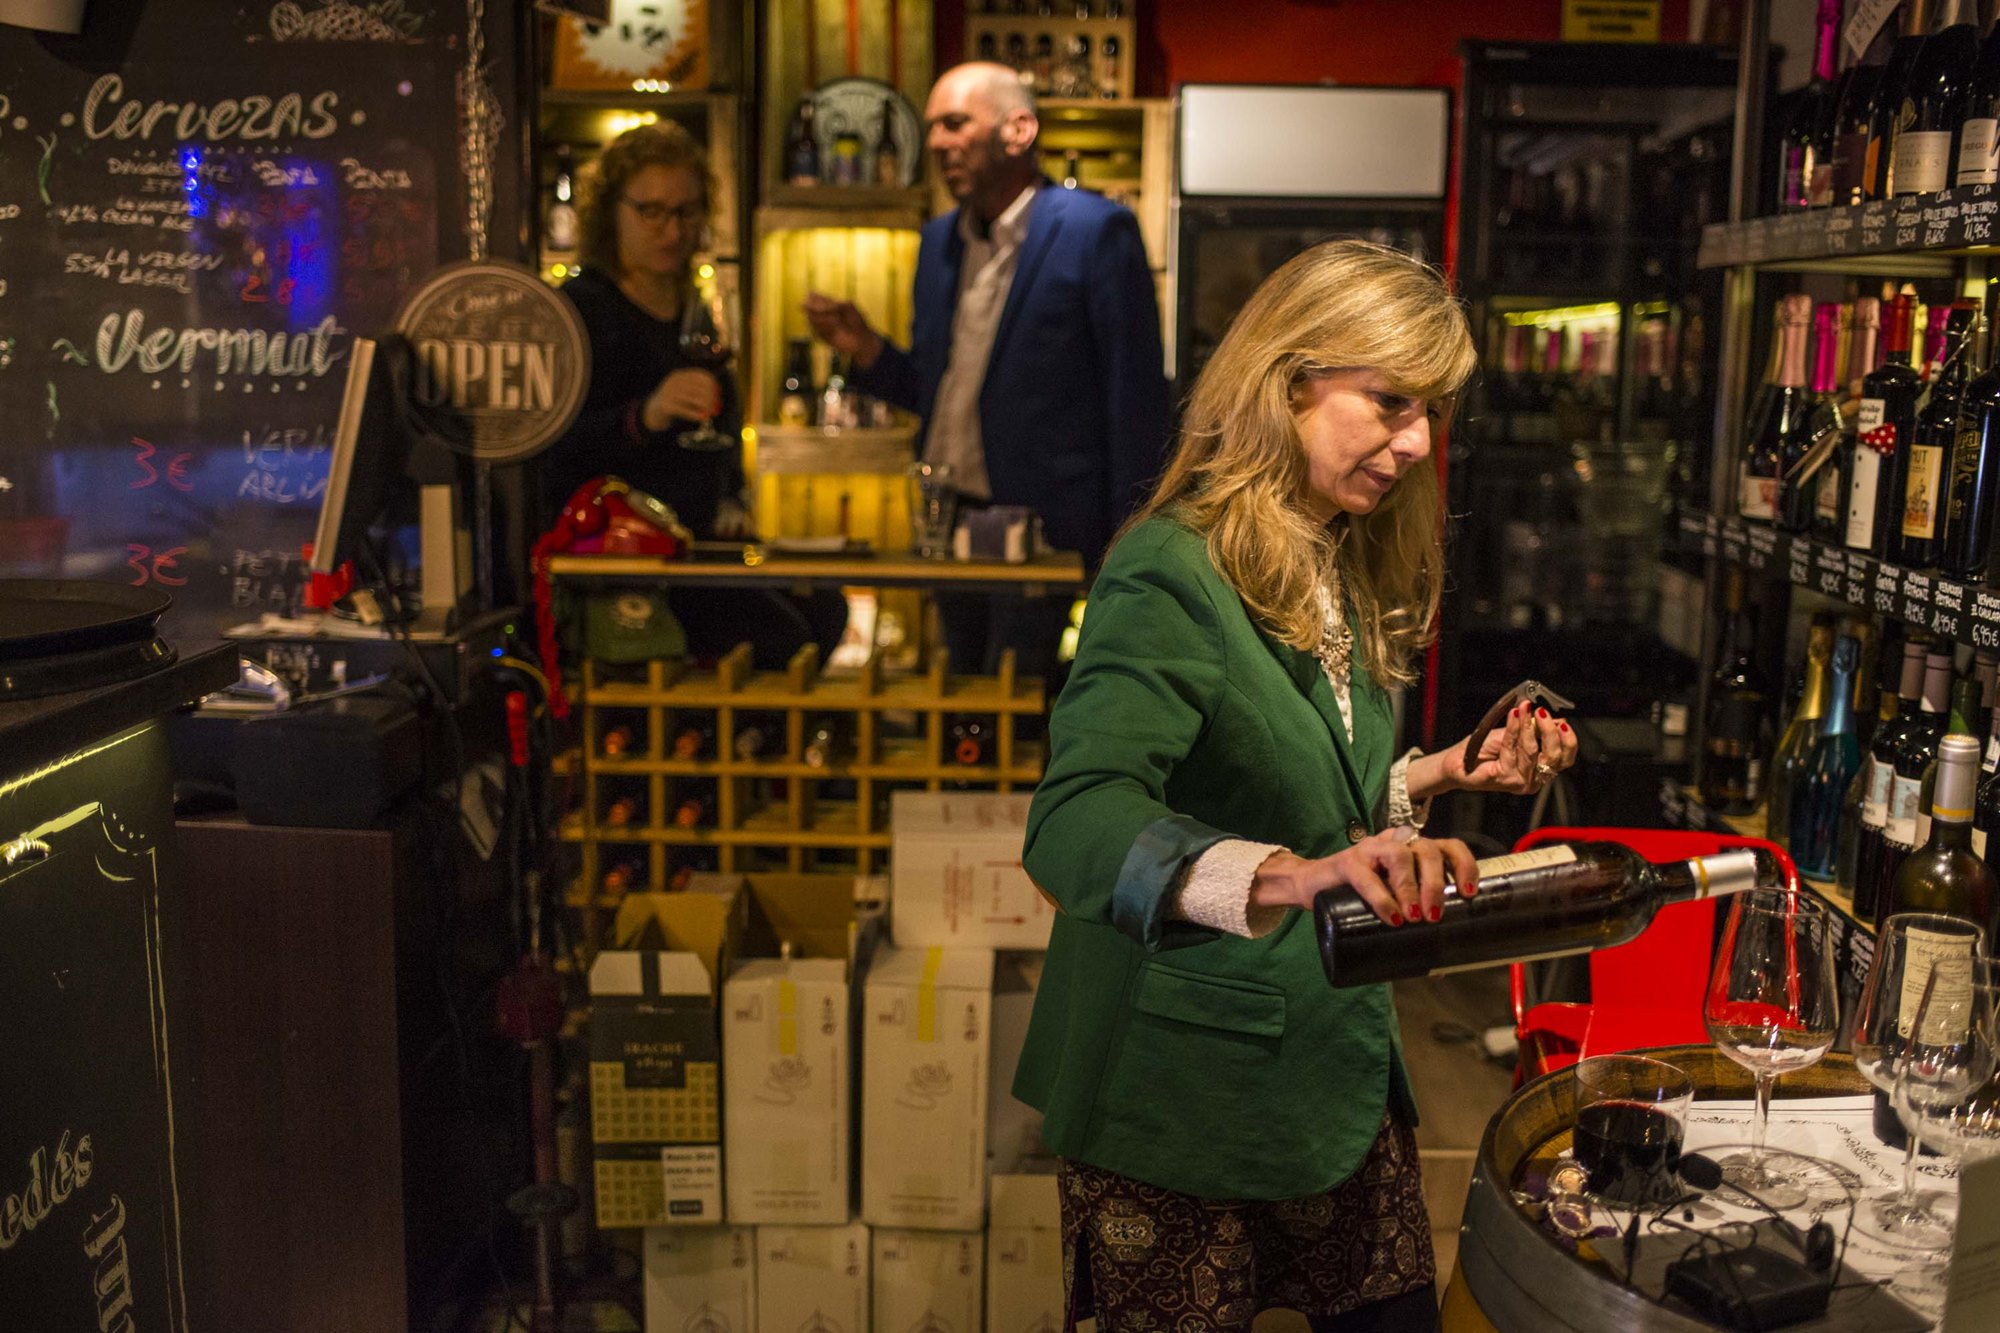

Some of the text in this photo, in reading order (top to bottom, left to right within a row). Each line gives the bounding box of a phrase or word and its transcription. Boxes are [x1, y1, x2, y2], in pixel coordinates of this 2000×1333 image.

[96, 309, 350, 377] Vermut
[416, 338, 557, 412] OPEN
[1972, 623, 1999, 648] 6,95€
